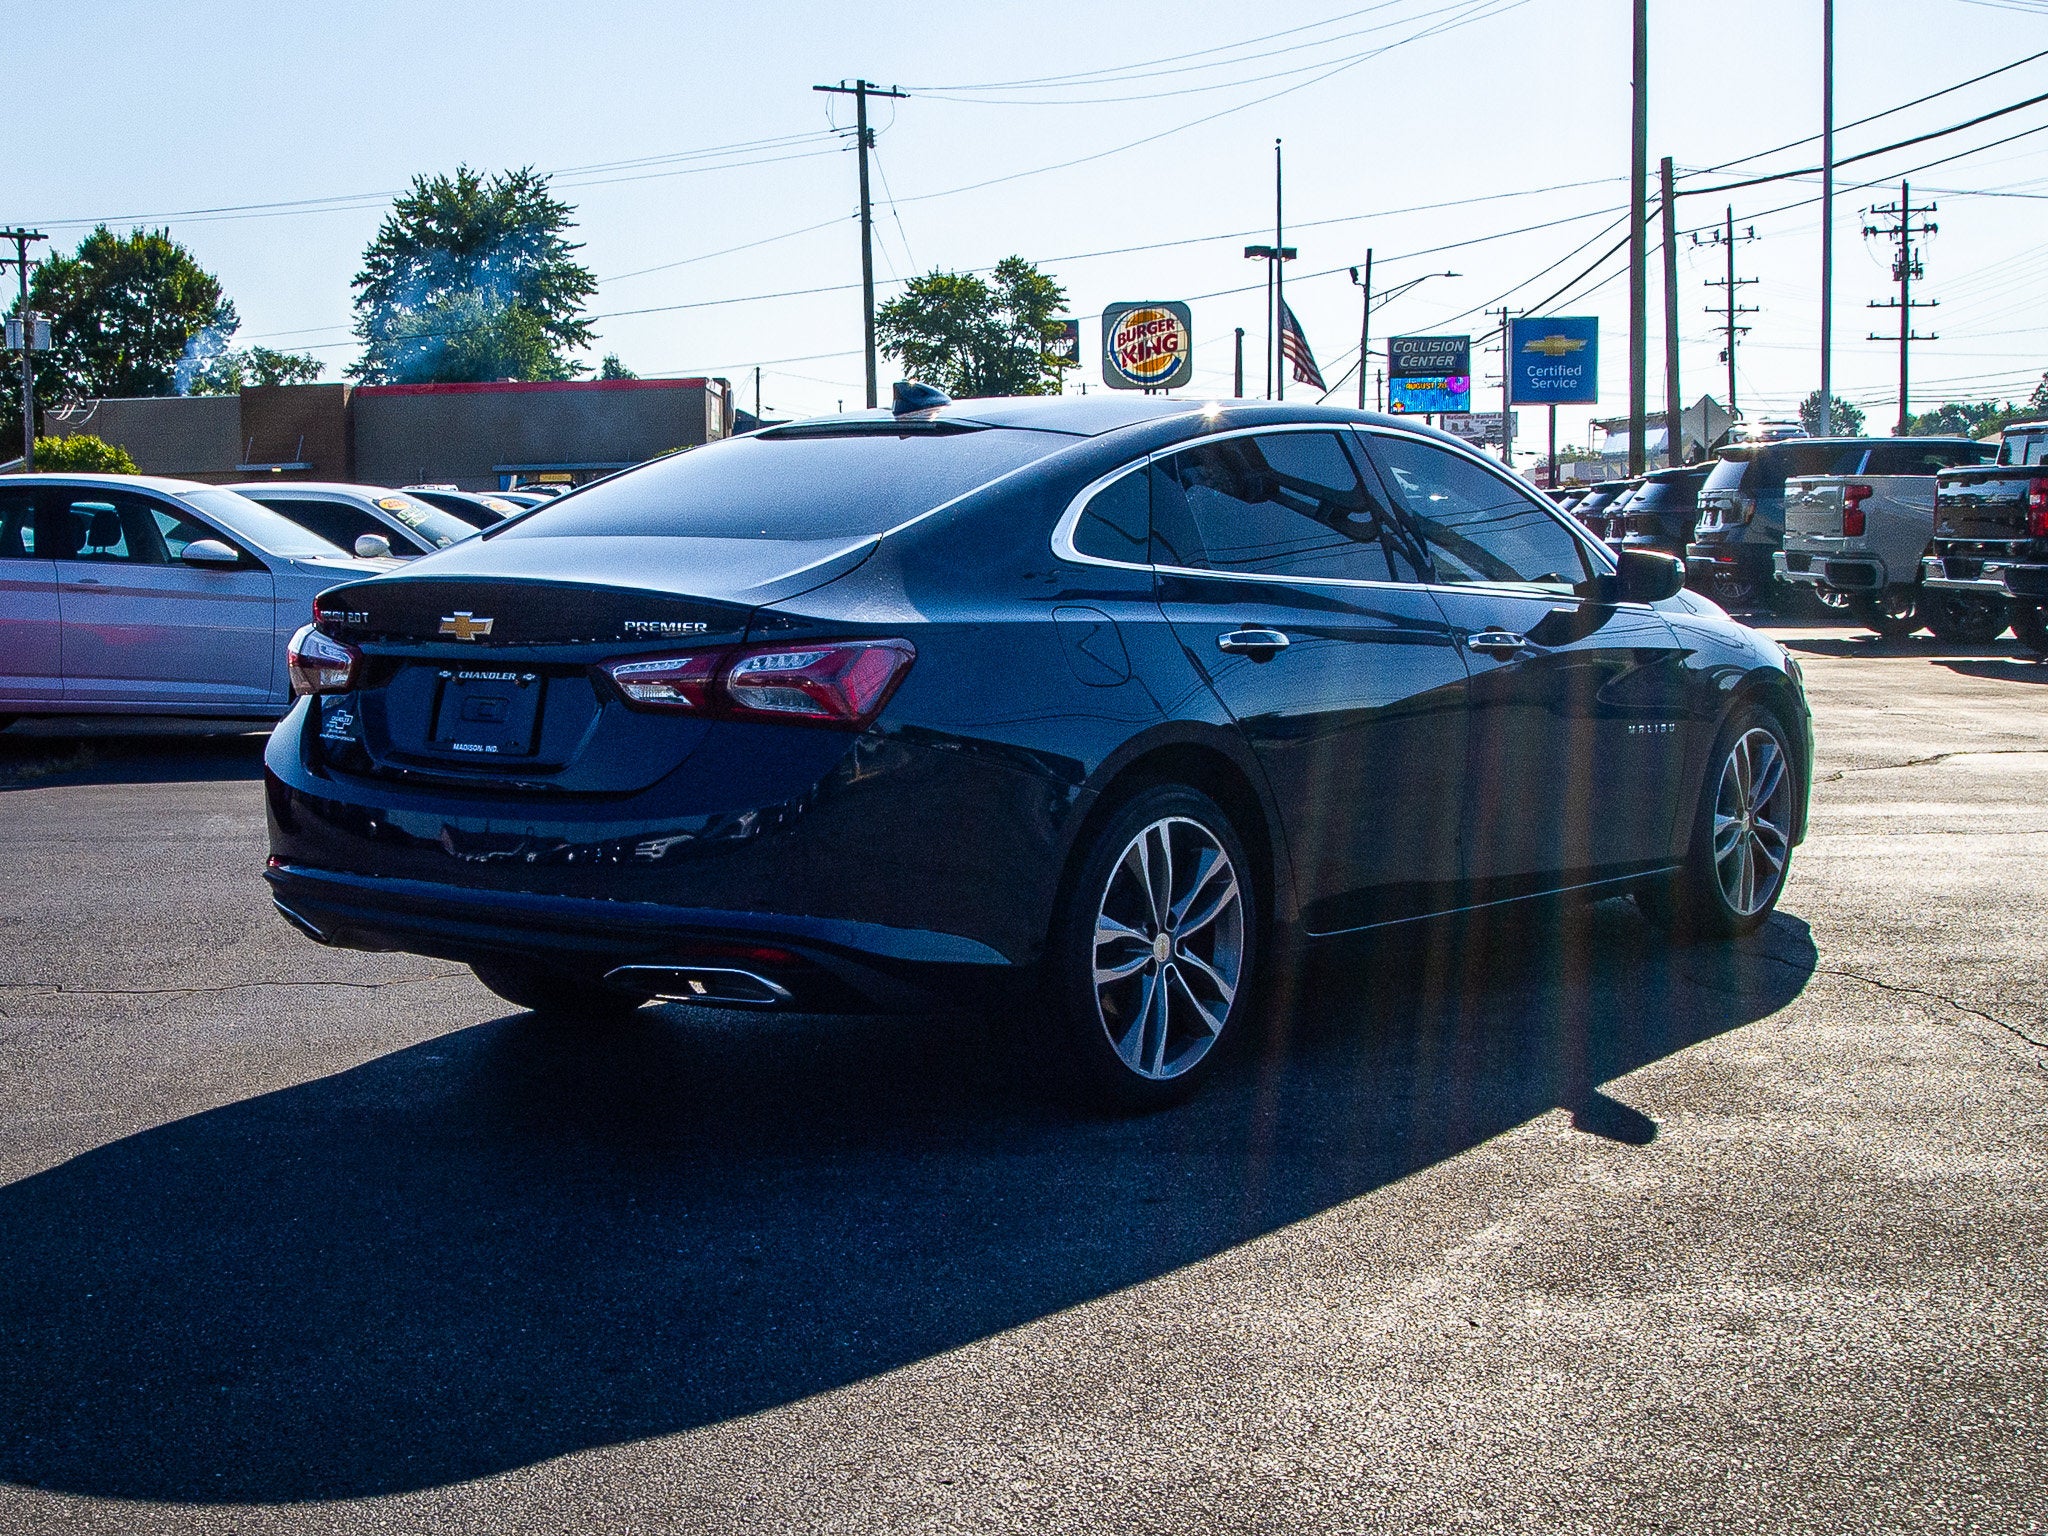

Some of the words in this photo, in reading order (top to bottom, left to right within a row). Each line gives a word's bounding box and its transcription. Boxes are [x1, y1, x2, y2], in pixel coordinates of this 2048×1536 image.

[1117, 318, 1176, 348] BURGER
[1121, 333, 1178, 369] KING
[1393, 340, 1465, 353] COLLISION
[1400, 355, 1455, 367] CENTER
[1527, 365, 1582, 377] Certified
[1531, 378, 1578, 389] Service
[624, 621, 708, 632] PREMIER
[458, 671, 517, 681] CHANDLER
[1628, 723, 1675, 734] MALIBU
